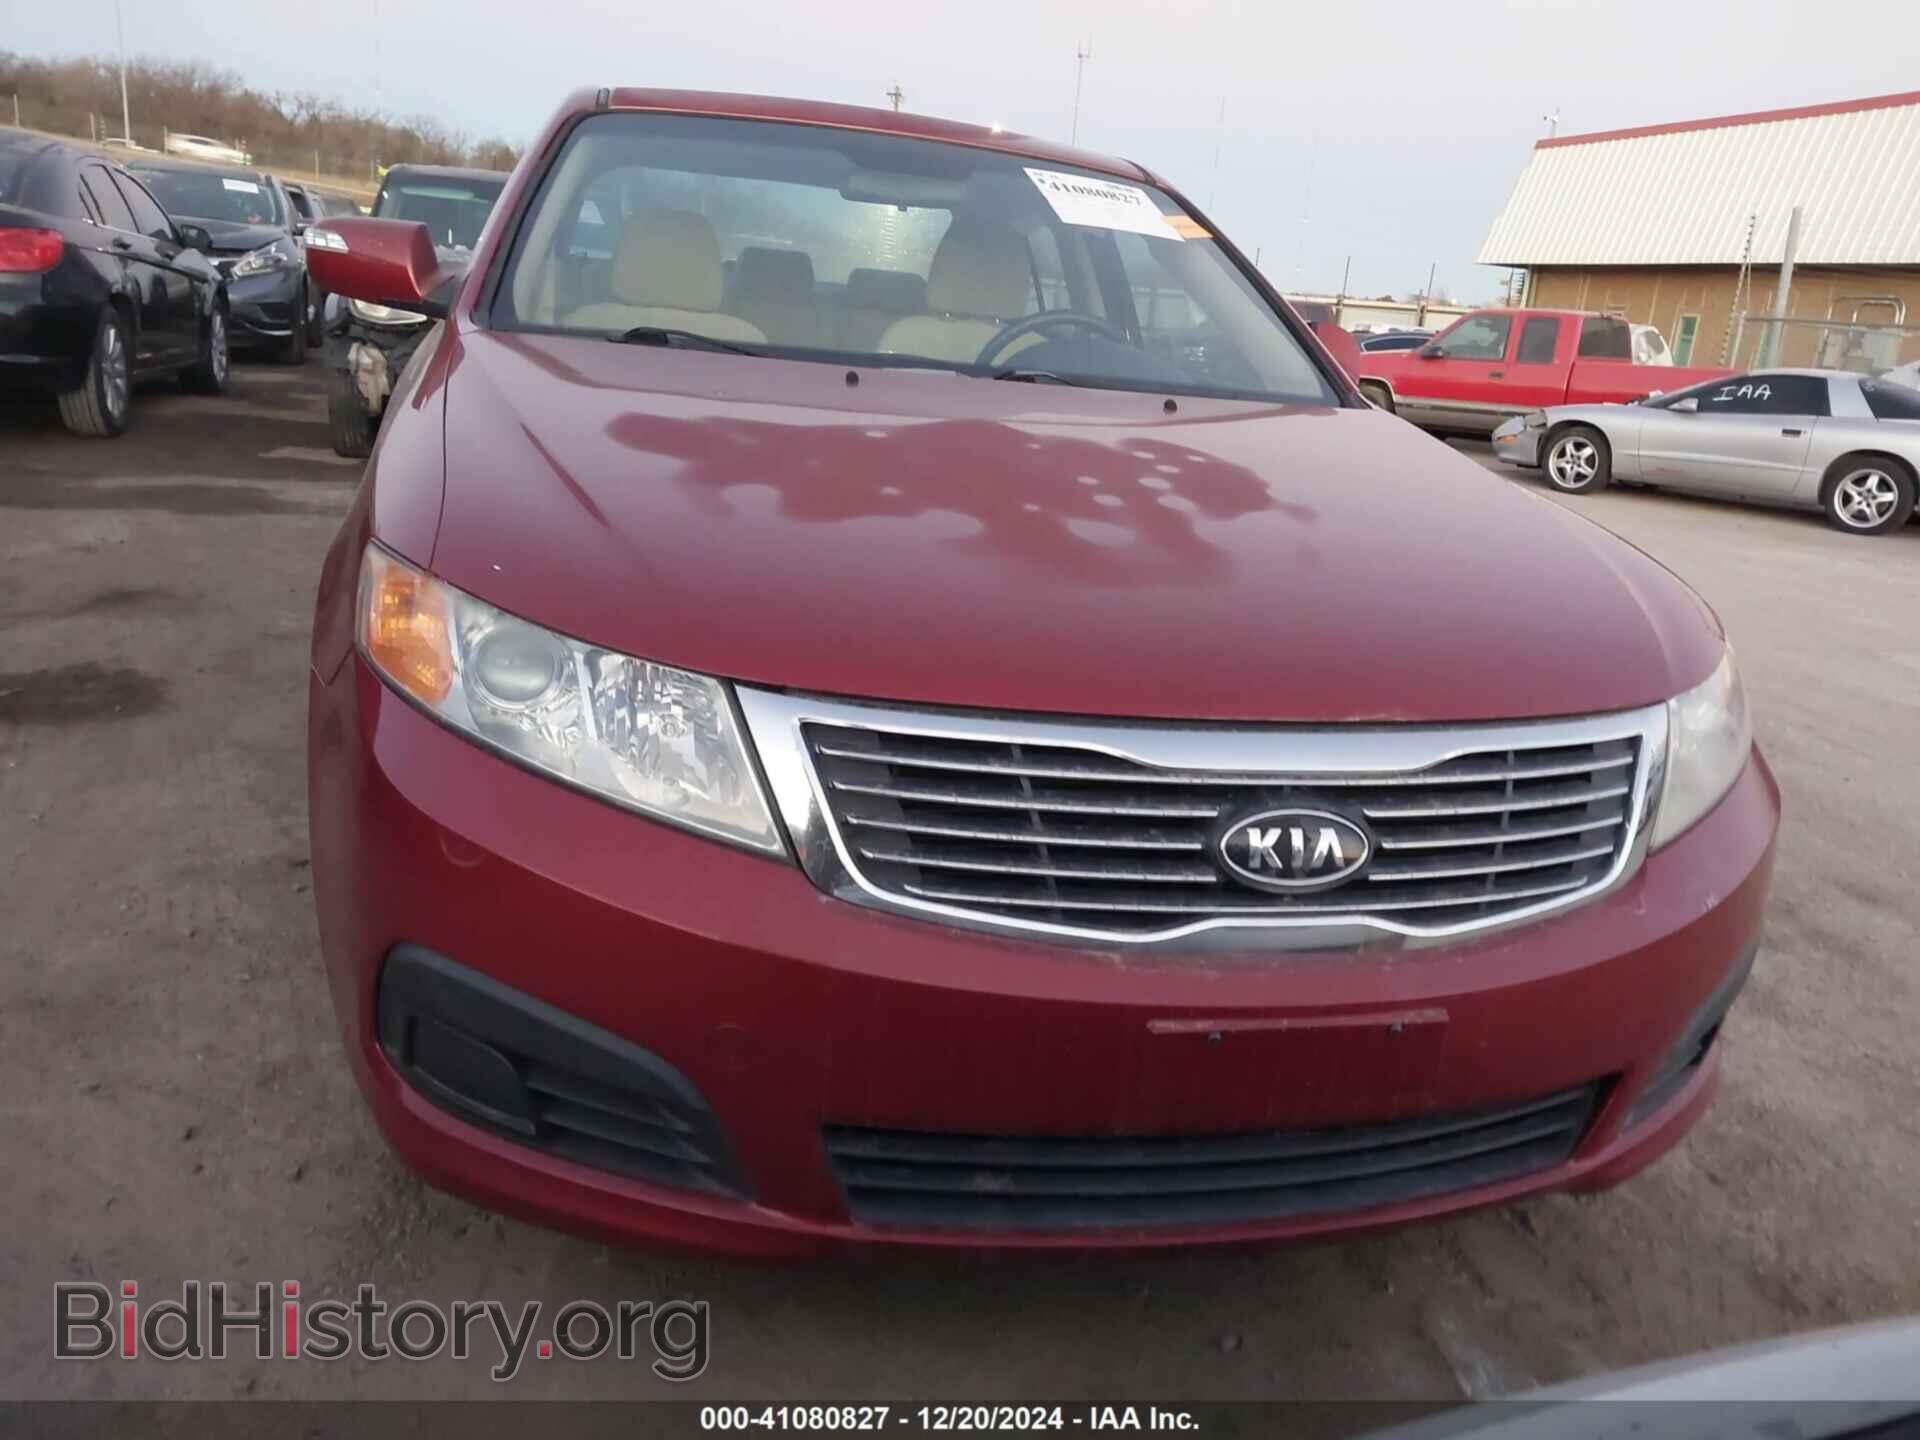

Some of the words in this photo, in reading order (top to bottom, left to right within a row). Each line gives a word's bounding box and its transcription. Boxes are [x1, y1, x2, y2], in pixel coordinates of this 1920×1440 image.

[1049, 182, 1142, 206] 41080827
[1712, 384, 1772, 401] IAA
[1247, 827, 1344, 869] KIA
